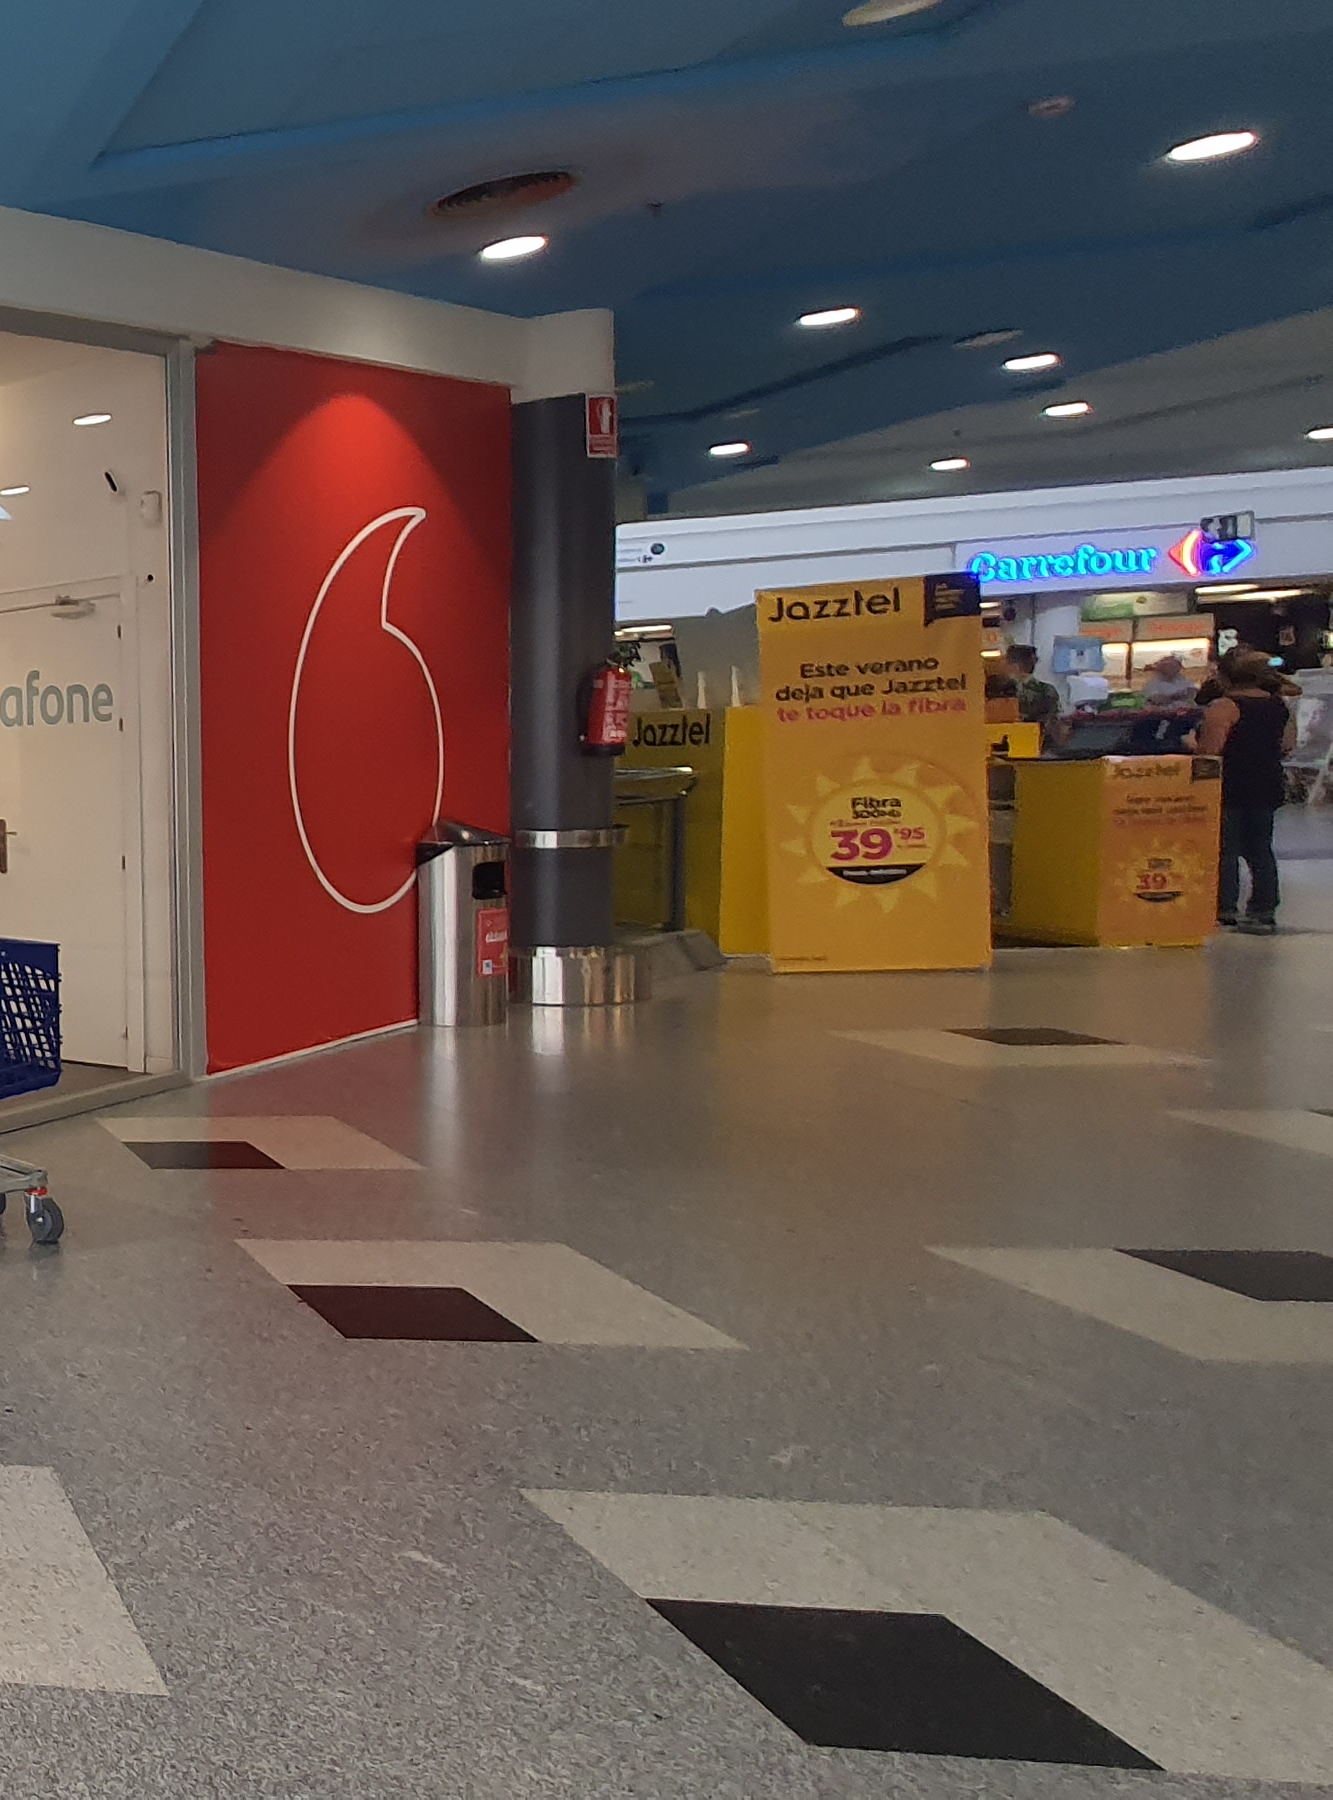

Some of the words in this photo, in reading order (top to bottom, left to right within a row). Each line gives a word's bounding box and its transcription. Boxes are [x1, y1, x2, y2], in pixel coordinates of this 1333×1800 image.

[969, 543, 1158, 582] Carrefour
[768, 586, 901, 622] Jazztel
[800, 662, 850, 679] Este
[856, 657, 940, 675] verano
[775, 683, 824, 703] deja
[830, 682, 875, 700] que
[881, 673, 967, 695] Jazztel
[777, 706, 799, 723] te
[806, 703, 876, 722] toque
[882, 699, 901, 716] la
[907, 697, 967, 714] fibra
[631, 712, 711, 747] Jazztel
[830, 828, 893, 861] 39
